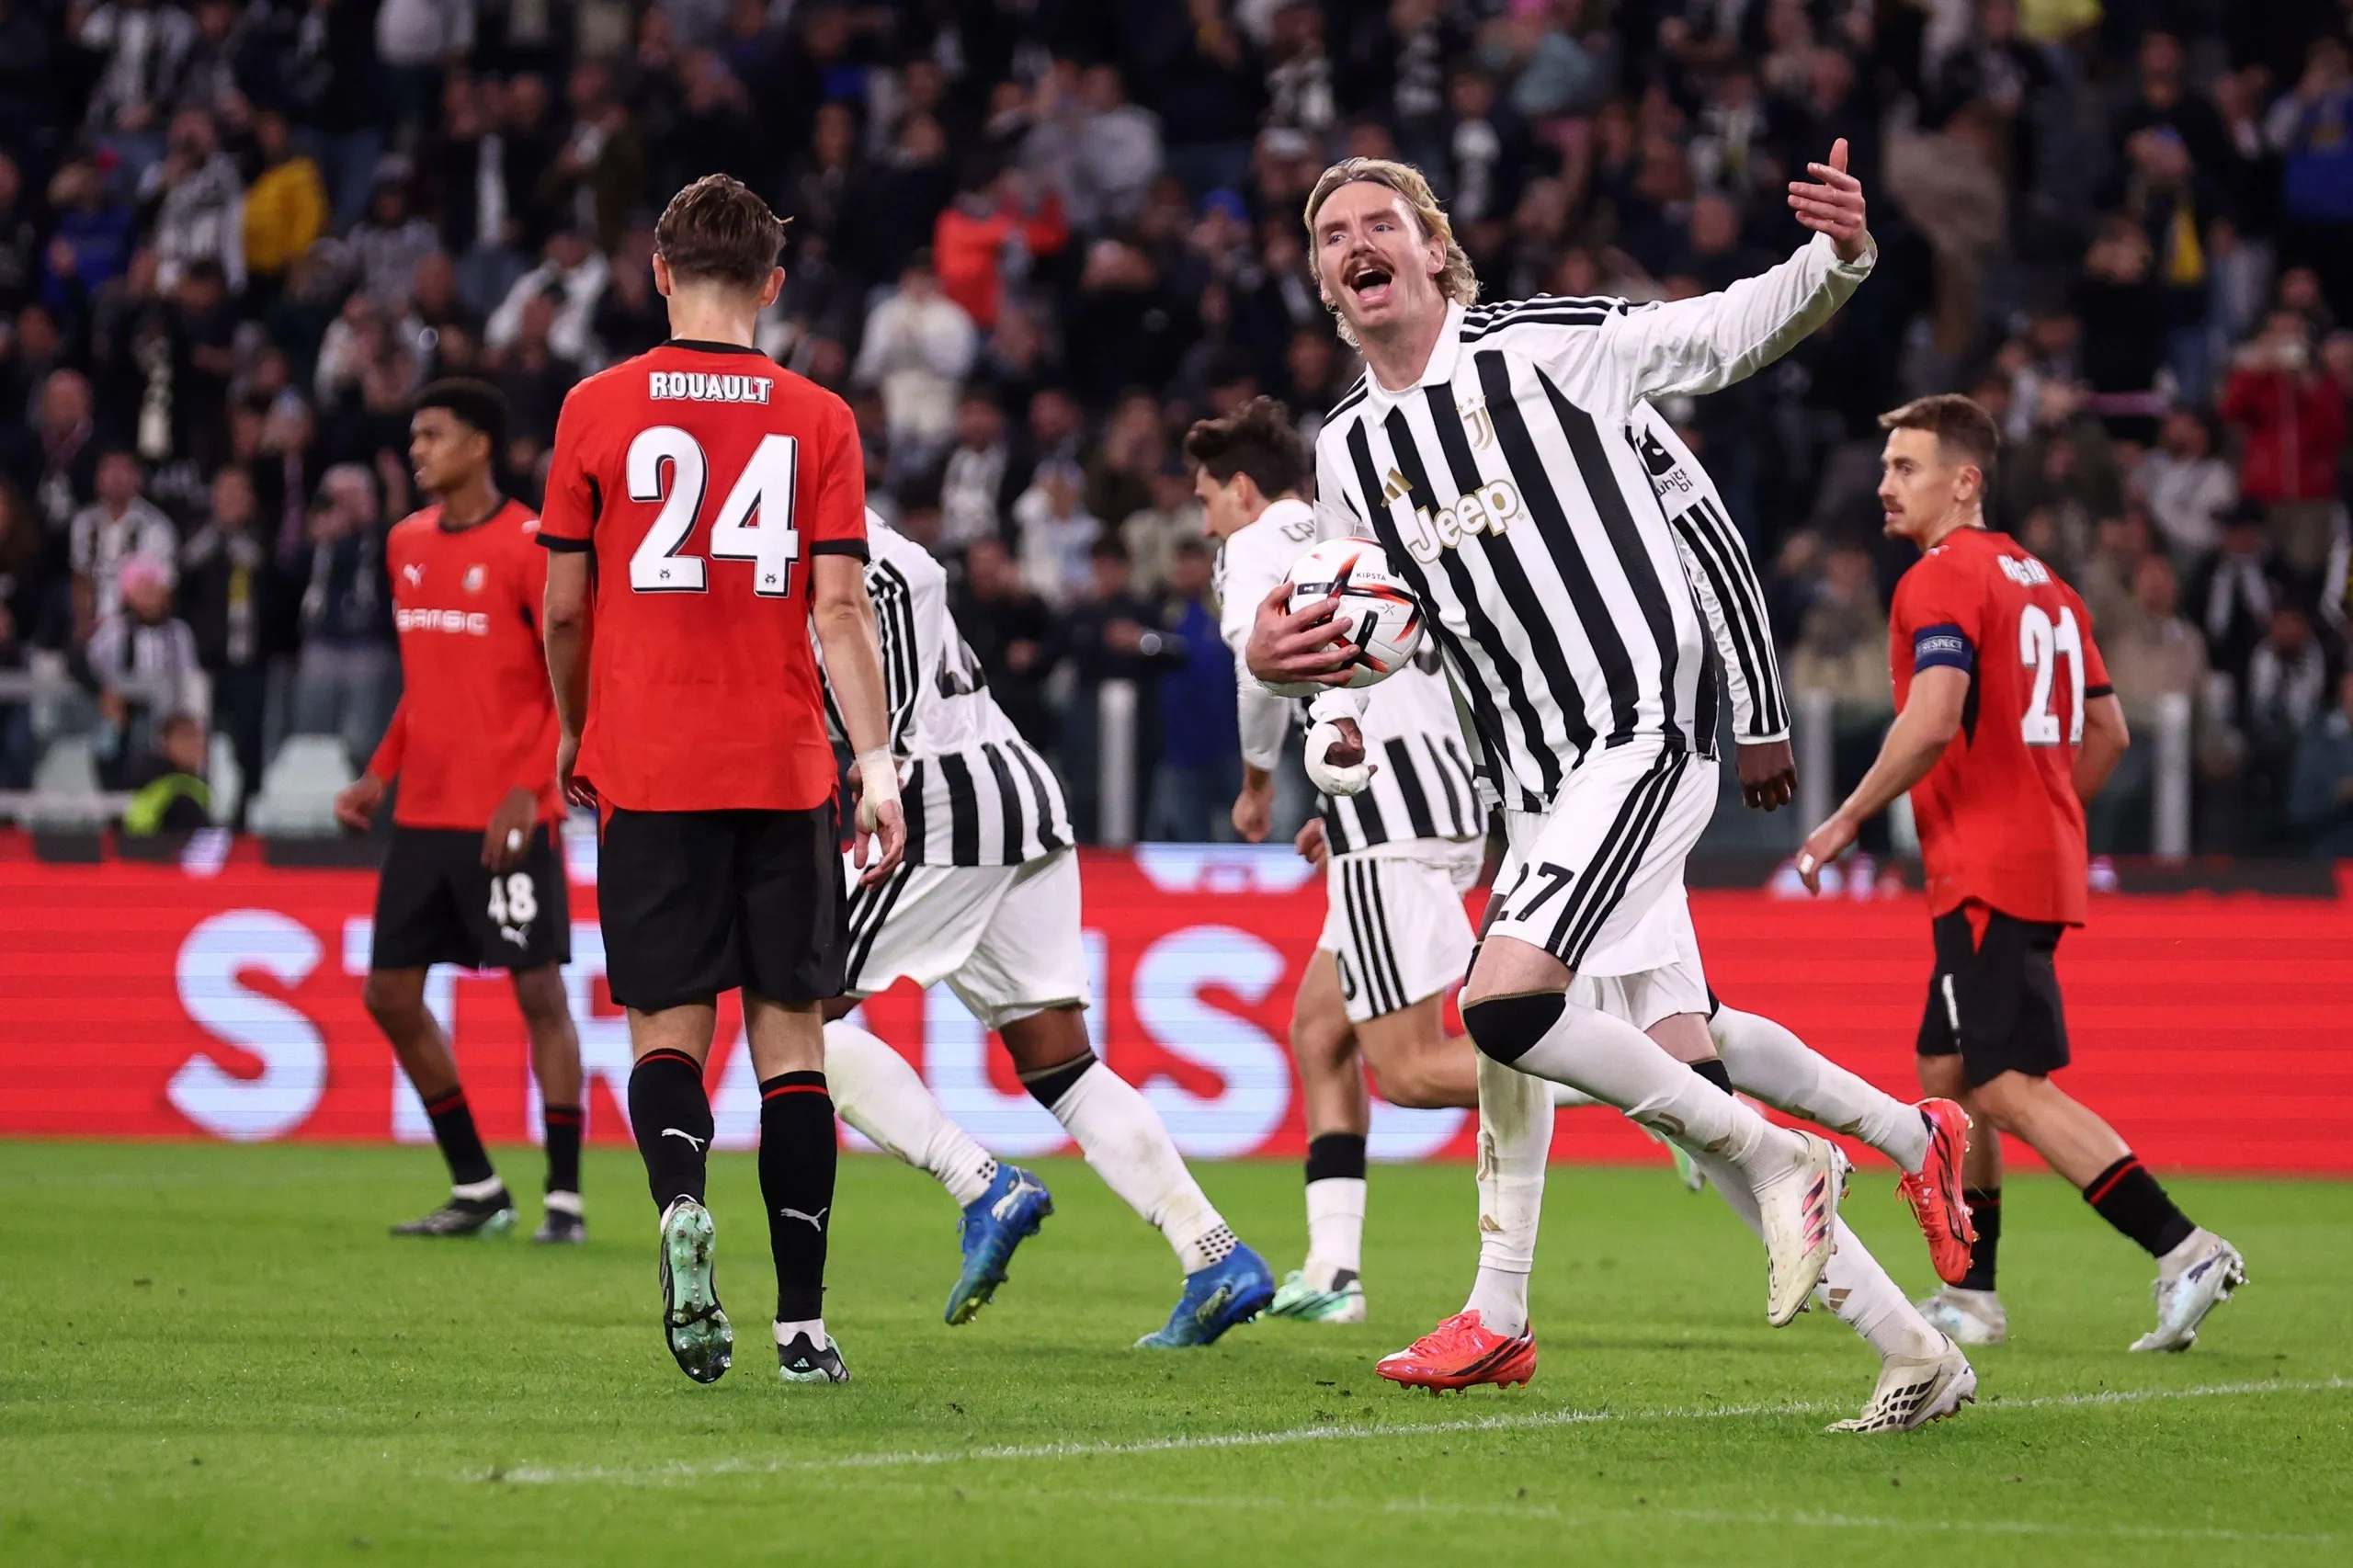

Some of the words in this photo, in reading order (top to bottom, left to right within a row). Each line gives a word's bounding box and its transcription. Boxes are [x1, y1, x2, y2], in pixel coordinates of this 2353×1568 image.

[650, 371, 773, 404] ROUAULT
[627, 426, 799, 597] 24
[1408, 479, 1519, 564] Jeep
[1356, 572, 1387, 582] KIPSTA
[2019, 603, 2086, 748] 21
[487, 871, 538, 926] 48
[1494, 861, 1574, 922] 27
[168, 908, 1471, 1161] SRUS
